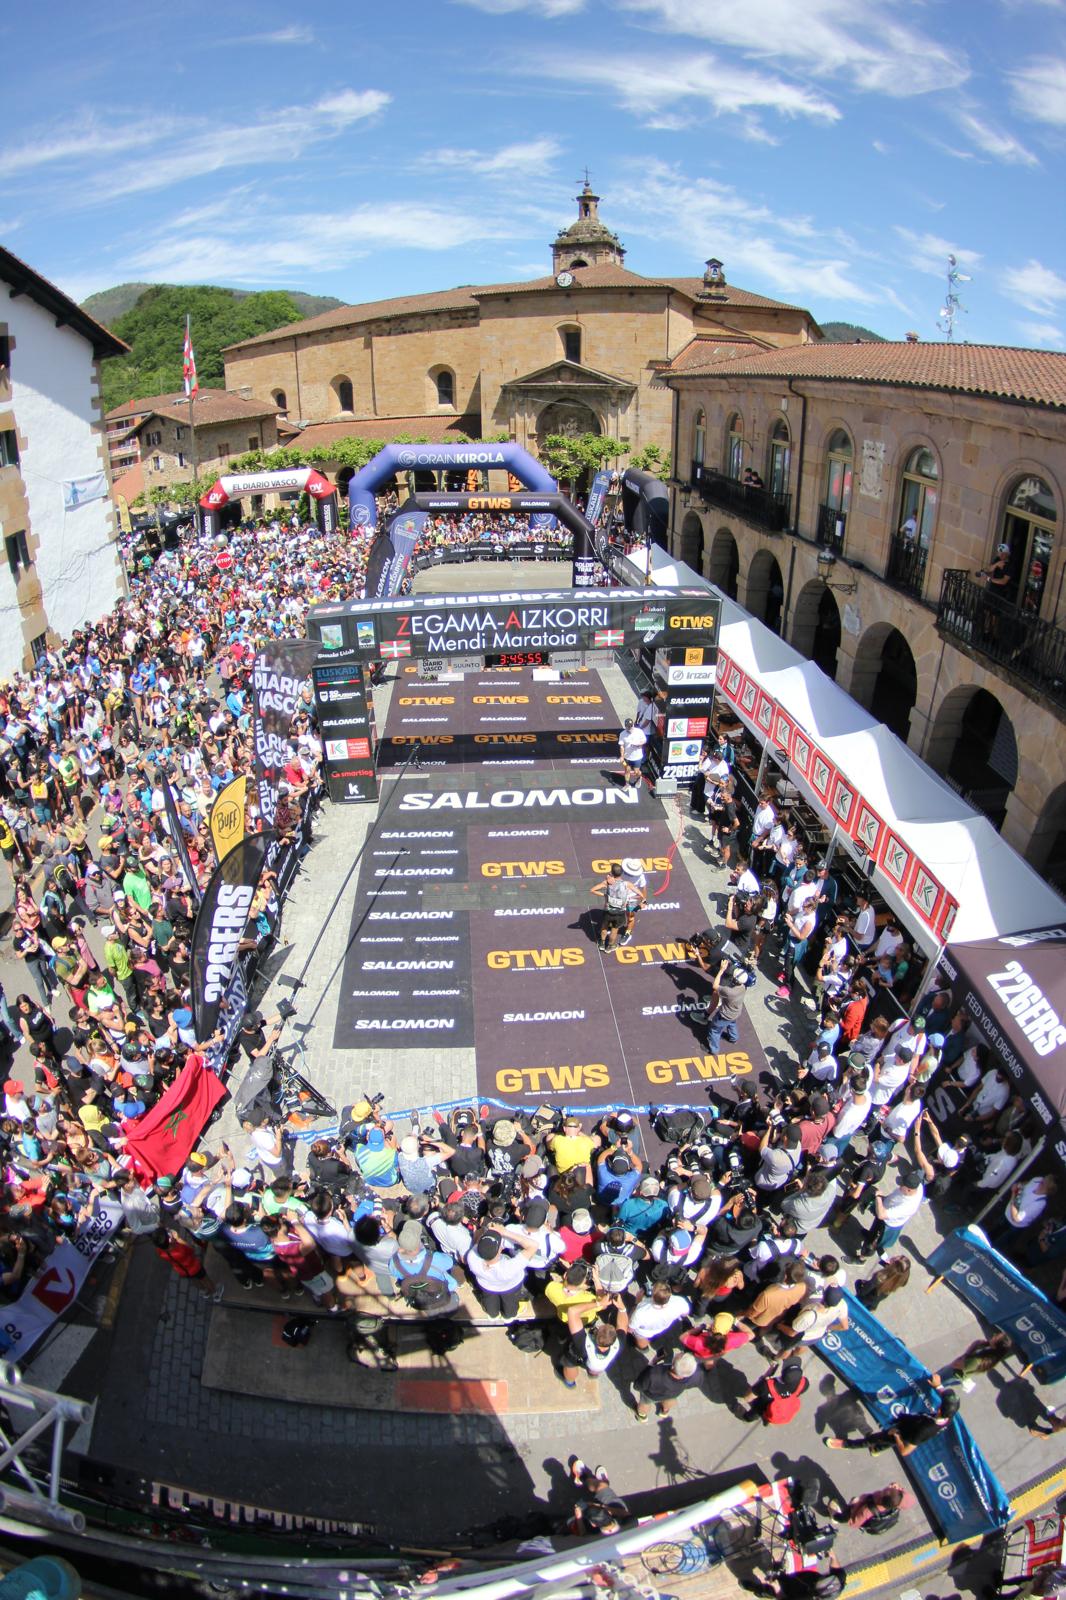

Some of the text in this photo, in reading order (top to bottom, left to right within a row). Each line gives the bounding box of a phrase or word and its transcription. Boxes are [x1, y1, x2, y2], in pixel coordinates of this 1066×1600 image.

[418, 452, 504, 464] ORAINKIROLA
[243, 481, 269, 489] DIARIO
[209, 493, 221, 501] DV
[468, 498, 511, 509] GTWS
[397, 608, 608, 636] ZEGAMA-AIZKORRI
[670, 616, 713, 628] GTWS
[428, 630, 577, 652] Mendi Maratoia
[316, 667, 359, 677] EUSKADI
[399, 696, 455, 705] GTWS
[473, 695, 529, 704] GTWS
[546, 695, 602, 704] GTWS
[322, 718, 366, 727] SALOMON
[391, 735, 454, 744] GTWS
[474, 734, 537, 743] GTWS
[557, 733, 618, 742] GTWS
[399, 788, 639, 810] SALOMON
[380, 831, 454, 839] SALOMON
[488, 829, 549, 837] SALOMON
[374, 868, 454, 876] SALOMON
[481, 860, 565, 877] GTWS
[368, 911, 454, 920] SALOMON
[494, 907, 565, 916] SALOMON
[487, 947, 585, 969] GTWS
[361, 960, 454, 970] SALOMON
[986, 960, 1066, 1057] 226ERS
[503, 1010, 585, 1022] SALOMON
[355, 1019, 455, 1030] SALOMON
[965, 991, 1024, 1079] FEED YOUR DREAMS
[645, 1051, 753, 1085] GTWS
[495, 1063, 610, 1093] GTWS
[76, 1210, 108, 1252] DIARIO
[83, 1219, 113, 1257] VASCO
[856, 1325, 886, 1358] KIROLAK
